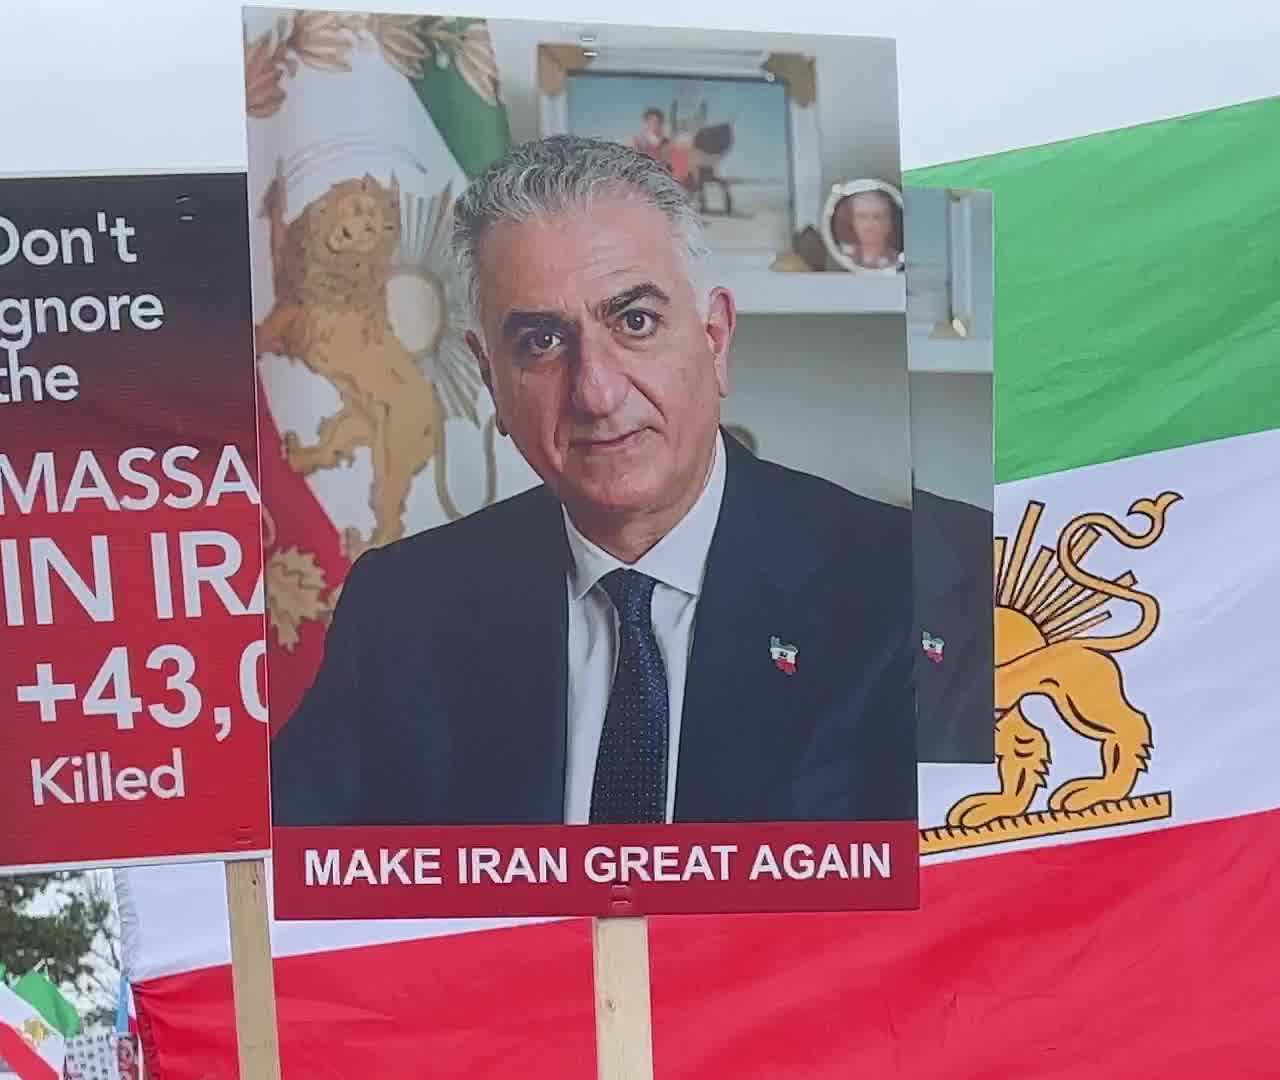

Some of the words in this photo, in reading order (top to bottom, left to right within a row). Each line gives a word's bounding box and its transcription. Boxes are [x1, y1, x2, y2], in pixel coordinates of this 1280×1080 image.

[0, 534, 116, 627] IN
[30, 747, 186, 806] Killed
[303, 847, 442, 886] MAKE
[458, 846, 569, 884] IRAN
[584, 843, 739, 883] GREAT
[749, 842, 892, 881] AGAIN
